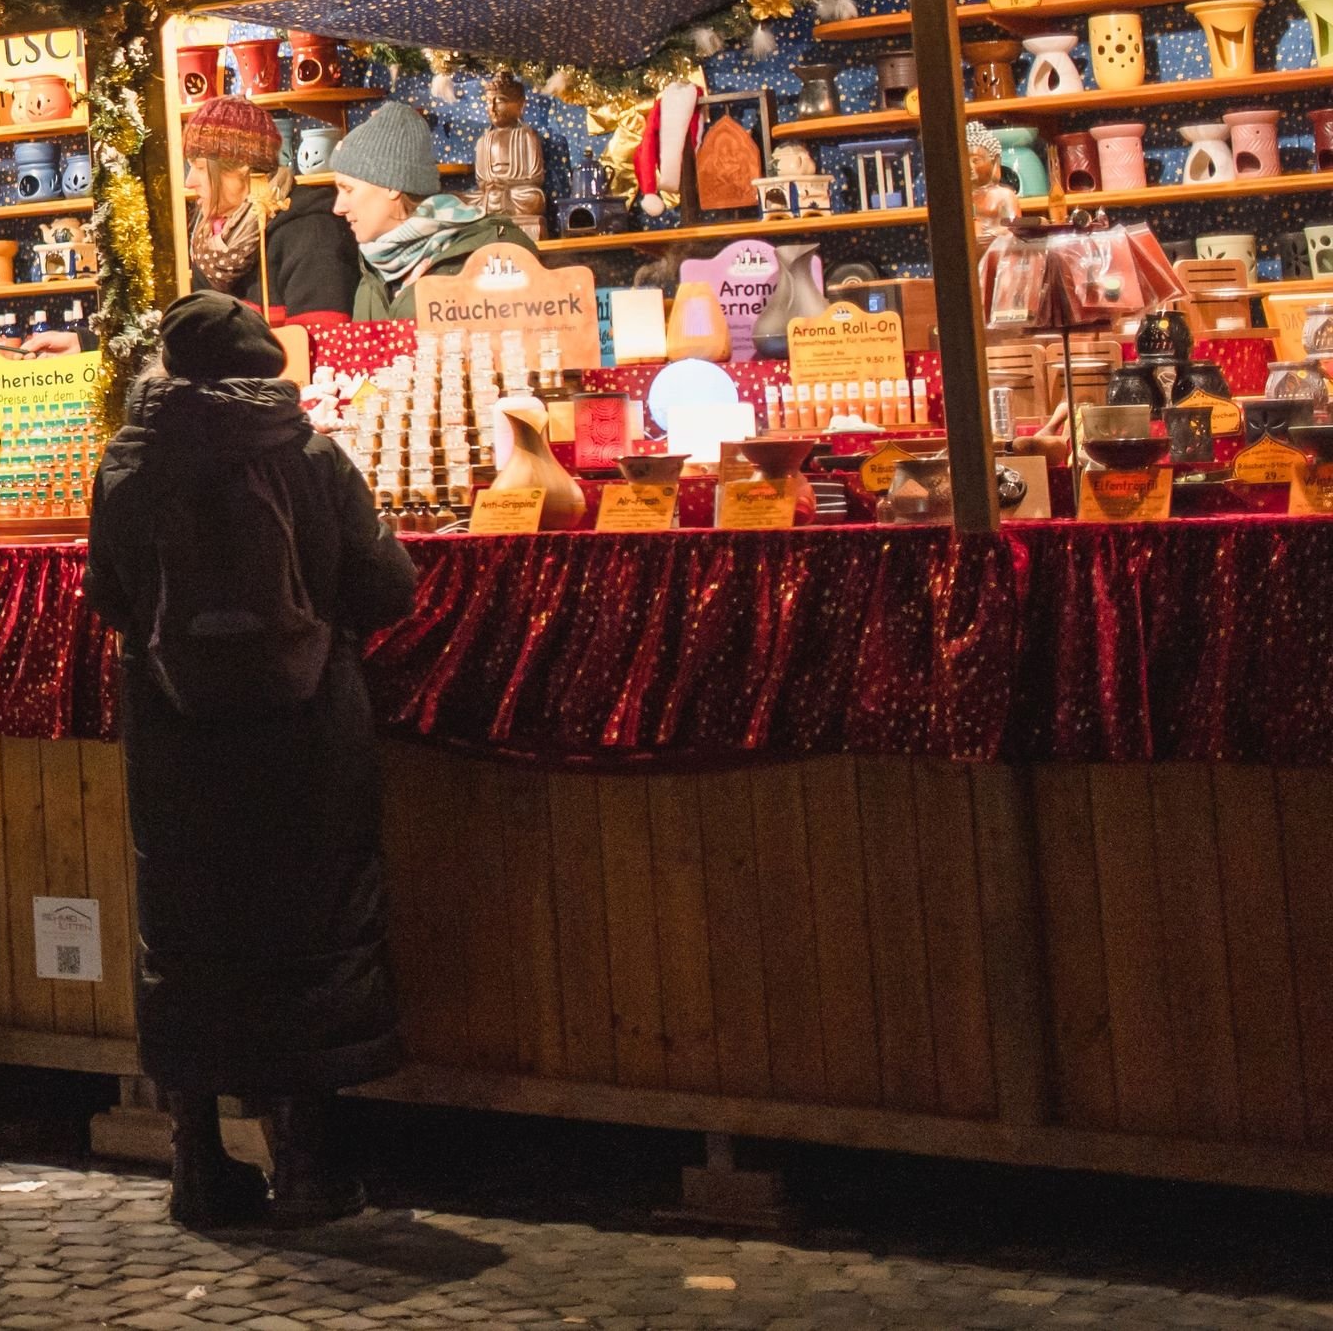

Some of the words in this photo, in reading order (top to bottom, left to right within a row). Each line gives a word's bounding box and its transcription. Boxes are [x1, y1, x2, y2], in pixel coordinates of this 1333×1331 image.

[428, 293, 583, 322] Räucherwerk
[793, 325, 836, 337] Aroma
[842, 320, 897, 335] Roll-On
[32, 391, 48, 403] auf
[53, 389, 75, 402] dem
